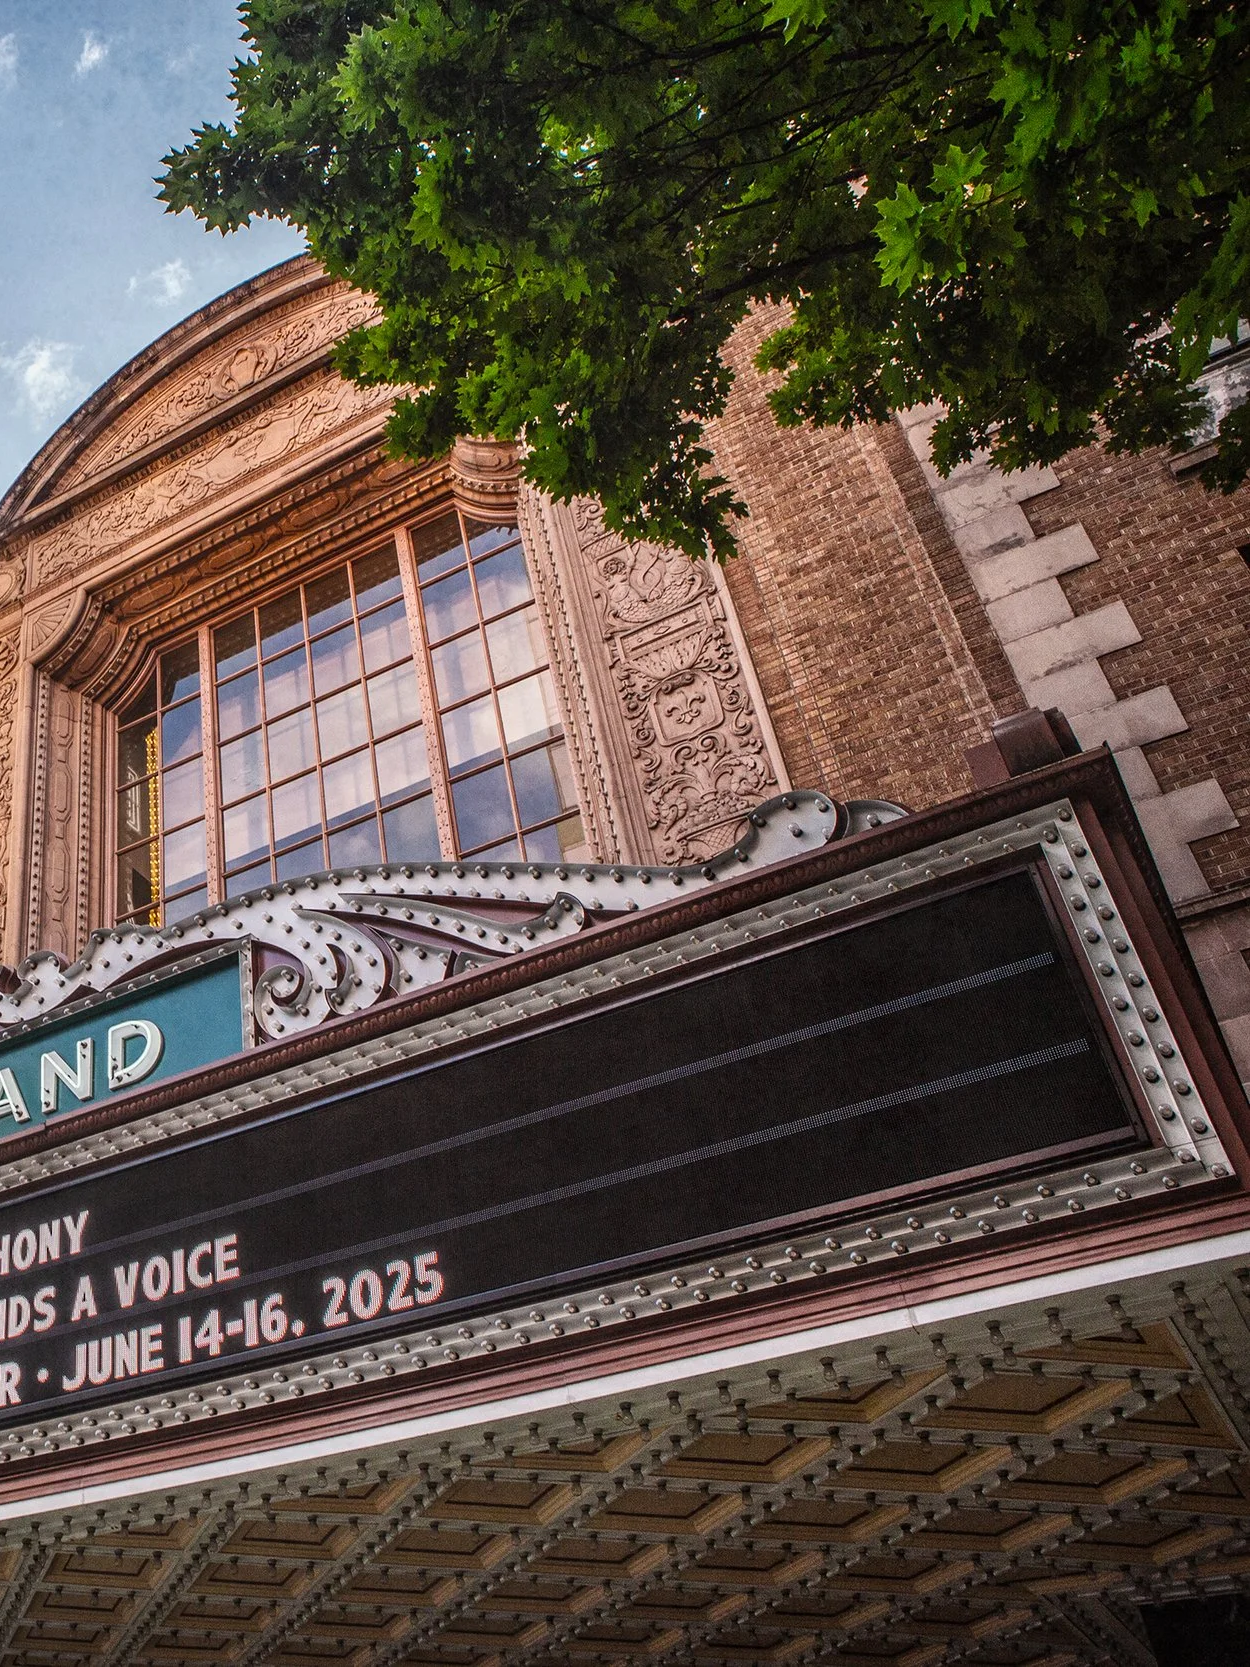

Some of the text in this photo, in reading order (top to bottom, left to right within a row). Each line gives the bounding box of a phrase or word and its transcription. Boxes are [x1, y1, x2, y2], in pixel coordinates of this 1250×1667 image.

[61, 1322, 165, 1392] JUNE
[322, 1250, 445, 1329] 2025
[70, 1274, 98, 1322] A
[113, 1233, 241, 1308] VOICE
